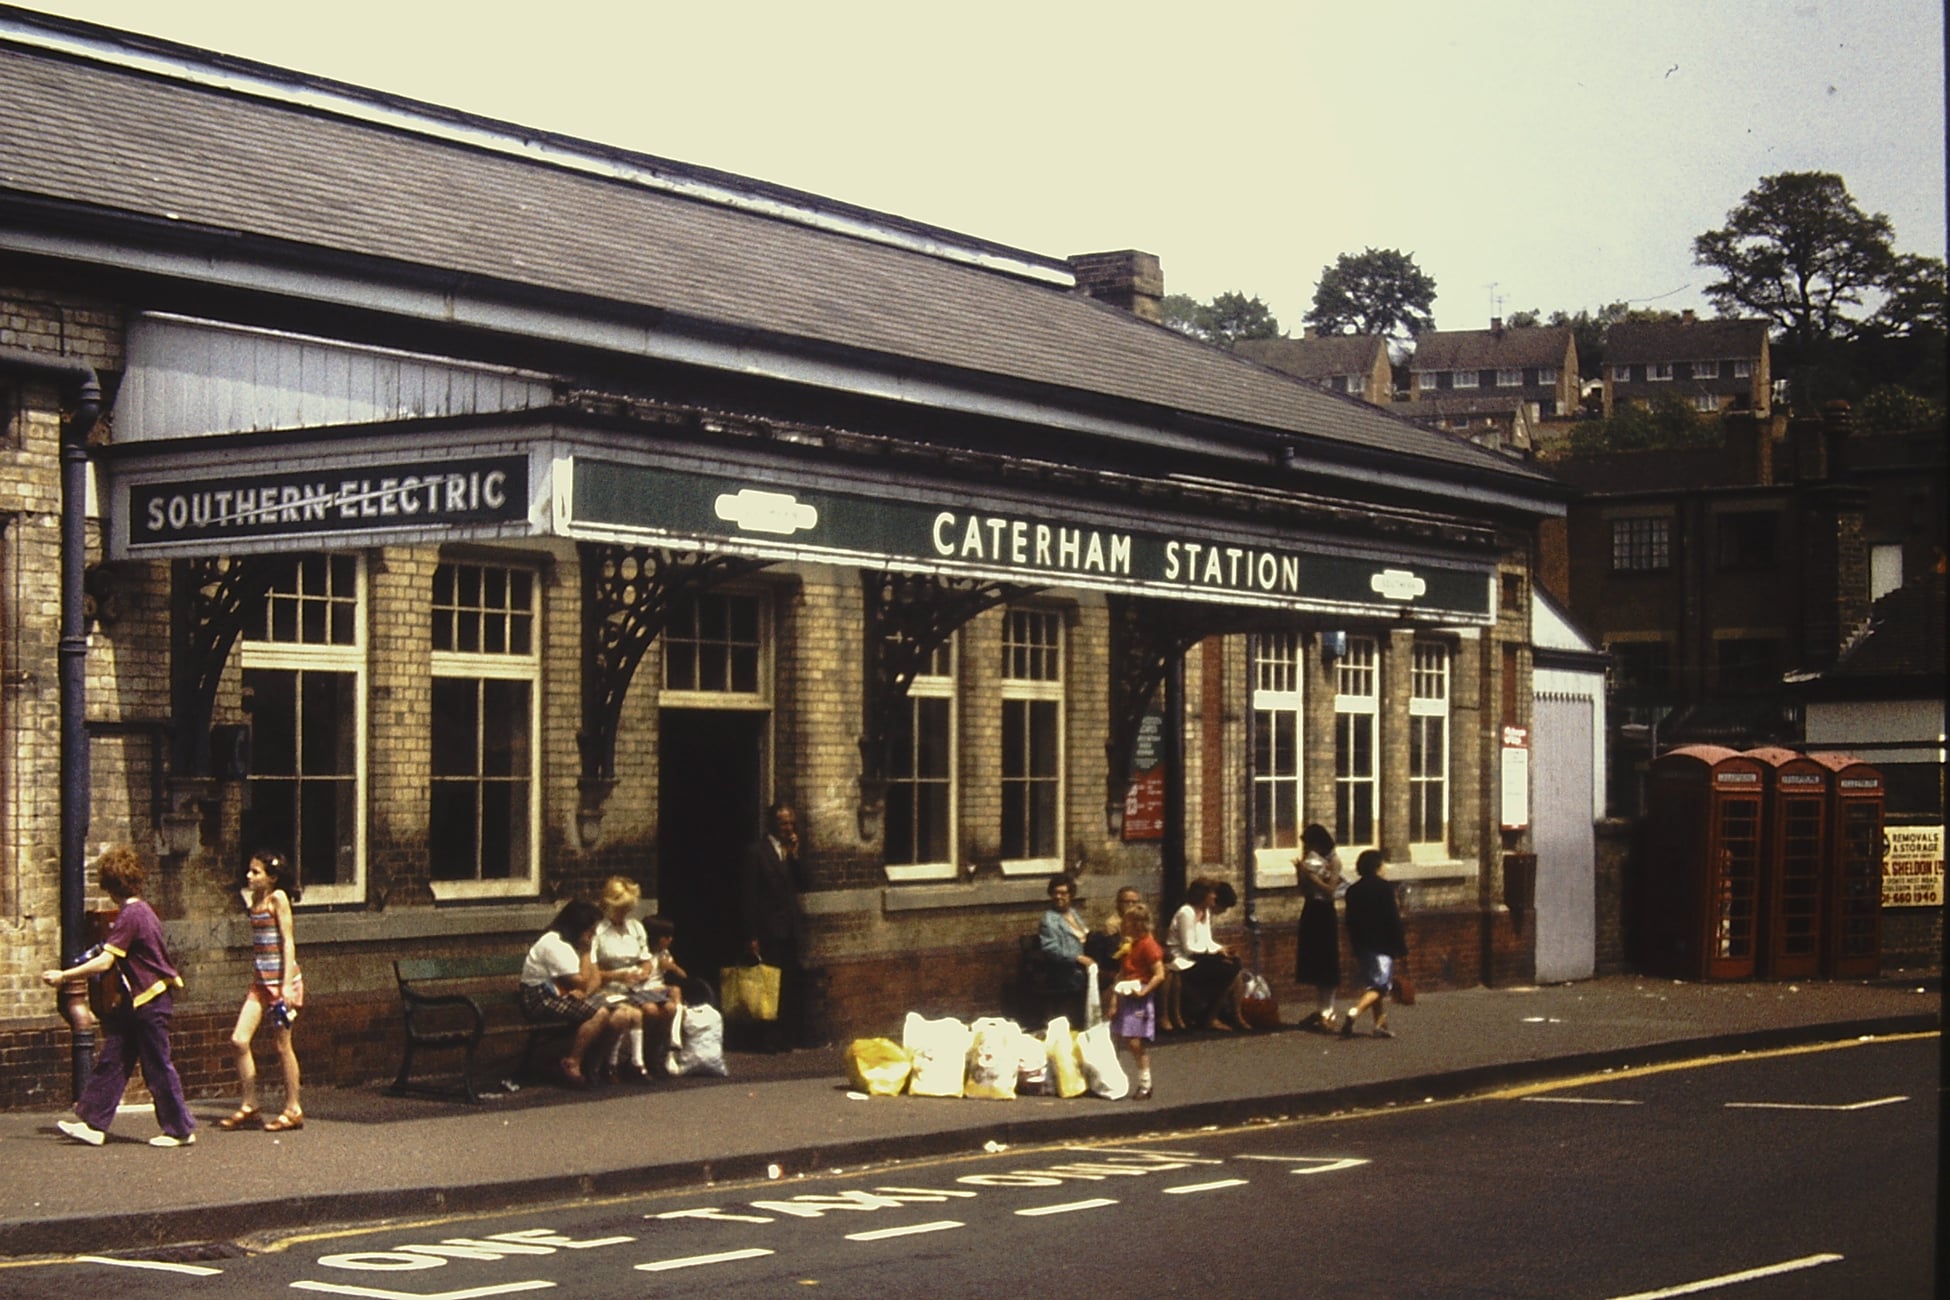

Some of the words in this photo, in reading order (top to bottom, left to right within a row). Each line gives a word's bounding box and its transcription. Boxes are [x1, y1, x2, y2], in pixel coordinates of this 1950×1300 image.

[146, 480, 327, 532] SOUTHERN
[339, 470, 506, 519] ELECTRIC
[932, 511, 1132, 574] CATERHAM
[1165, 540, 1299, 592] STATION
[1892, 833, 1939, 843] REMOVALS
[1900, 843, 1938, 853] STORAGE
[1892, 861, 1933, 876] SHELDON
[317, 1228, 637, 1271] ONE
[643, 1186, 978, 1224] TAXI
[956, 1145, 1223, 1187] ONLY
